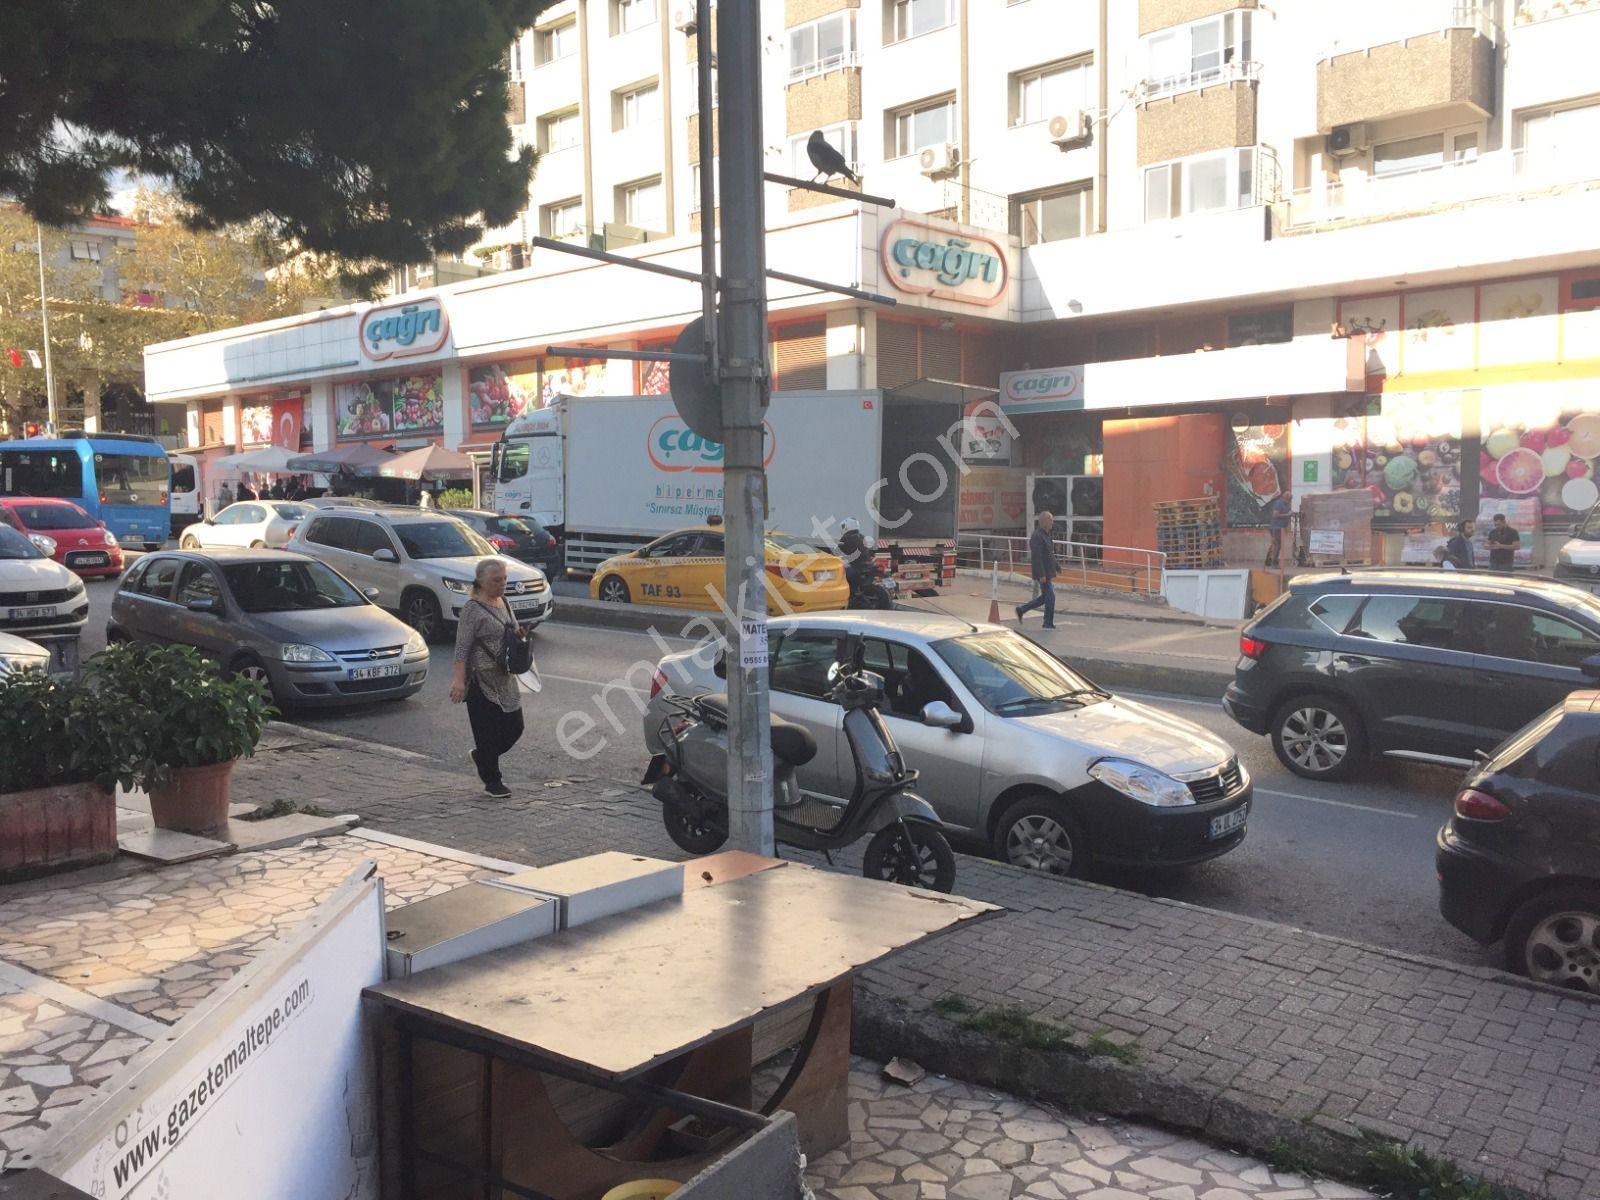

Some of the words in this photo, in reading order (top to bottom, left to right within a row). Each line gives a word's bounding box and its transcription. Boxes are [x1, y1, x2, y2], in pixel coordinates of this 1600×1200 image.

[893, 239, 999, 287] çağrı
[366, 306, 440, 350] çağrı
[640, 583, 662, 596] TAF
[666, 585, 681, 598] 93
[353, 668, 364, 679] 34
[367, 666, 381, 678] KBF
[384, 664, 400, 676] 372
[113, 978, 310, 1189] www.gazetemaltepe.com
